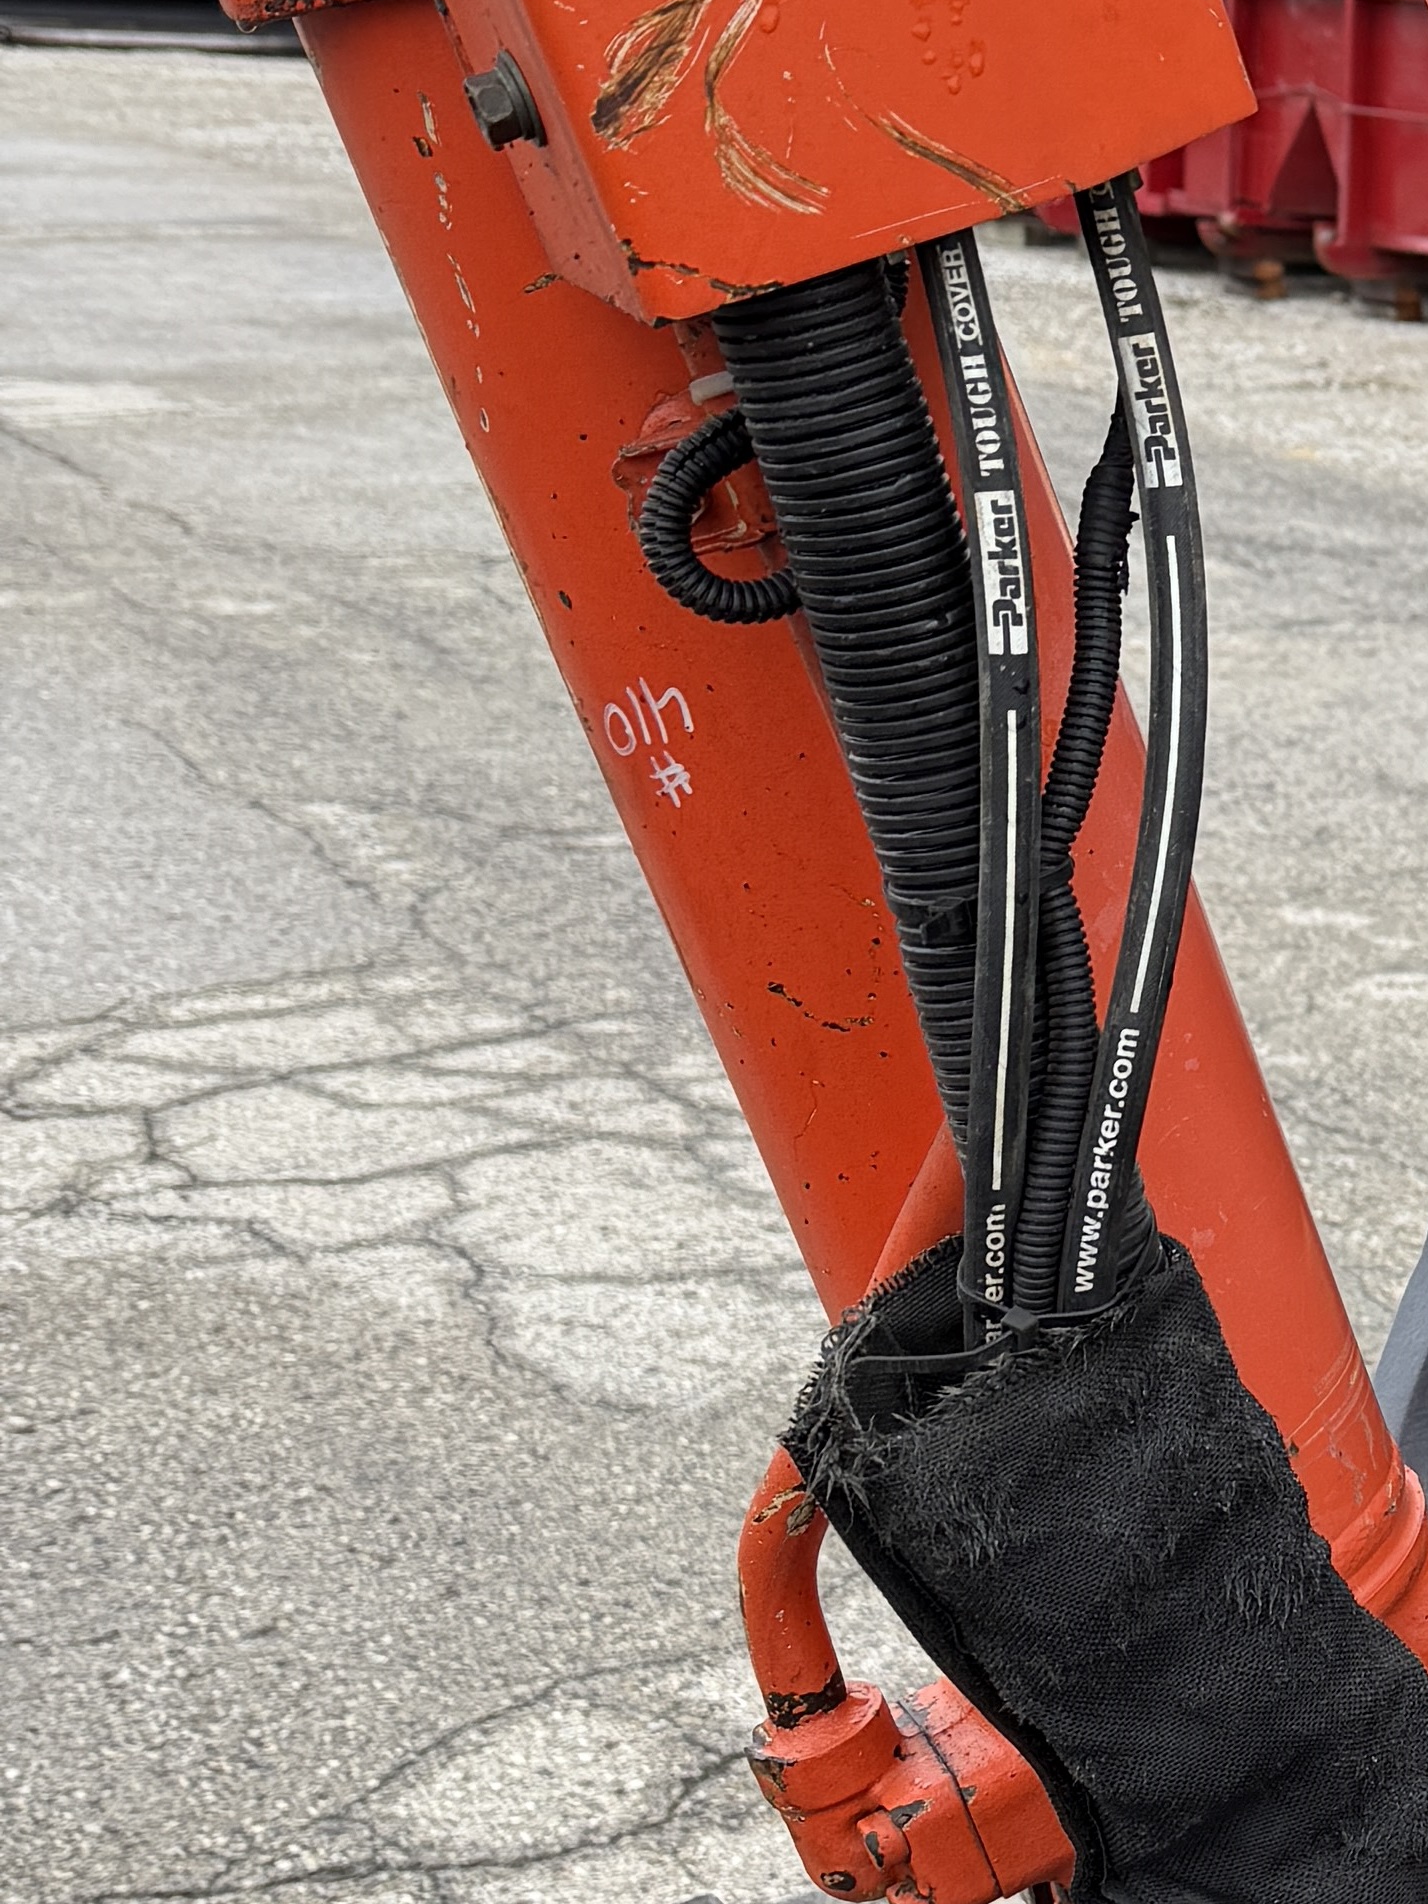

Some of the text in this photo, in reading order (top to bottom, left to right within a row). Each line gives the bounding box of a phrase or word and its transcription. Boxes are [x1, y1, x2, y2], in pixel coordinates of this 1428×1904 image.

[1096, 207, 1144, 325] TOUGH
[937, 242, 1028, 654] Parker TOUGH COVER
[1126, 337, 1182, 487] Parker
[1073, 1027, 1140, 1295] www.parker.com
